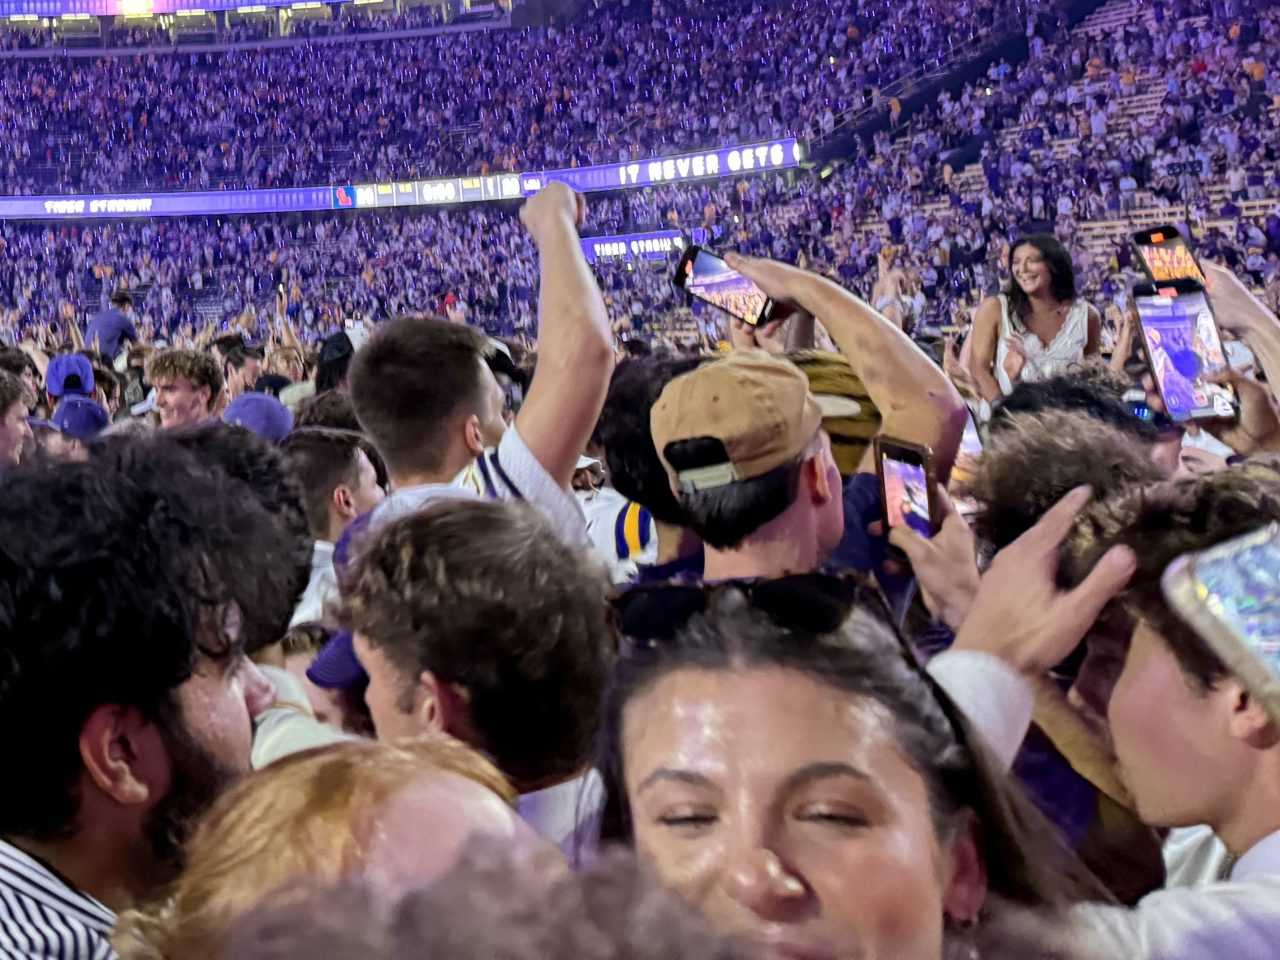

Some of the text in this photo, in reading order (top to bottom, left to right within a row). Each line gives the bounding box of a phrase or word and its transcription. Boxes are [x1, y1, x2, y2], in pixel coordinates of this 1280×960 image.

[620, 163, 640, 185] IT
[648, 154, 719, 182] NEVER
[727, 143, 784, 172] GETS
